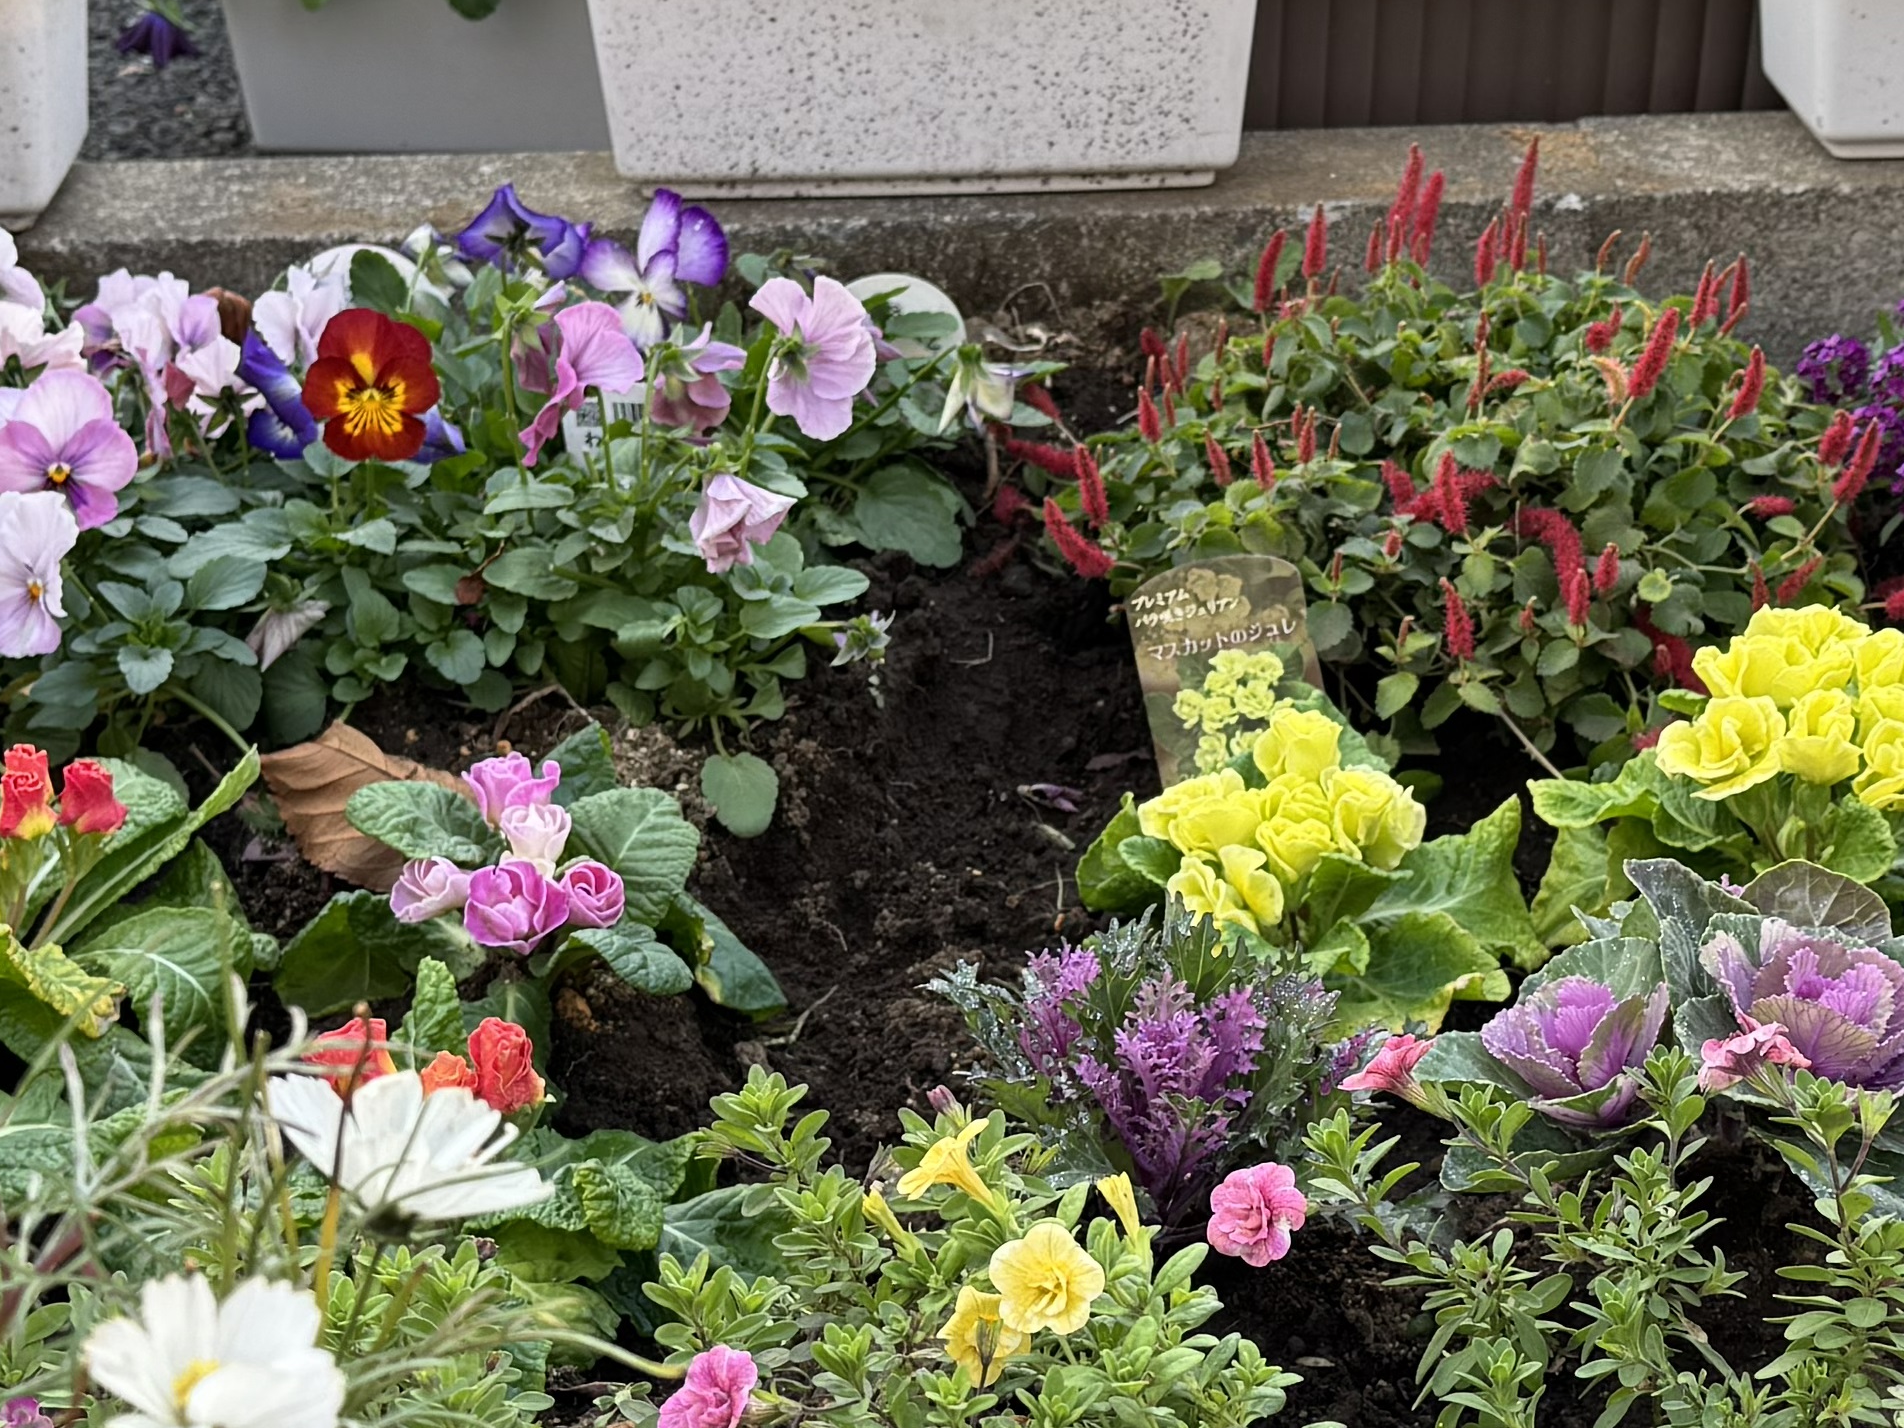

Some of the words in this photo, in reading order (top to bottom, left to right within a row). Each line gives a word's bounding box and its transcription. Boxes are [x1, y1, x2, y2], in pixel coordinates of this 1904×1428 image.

[1131, 588, 1190, 611] プレミアム
[1147, 618, 1296, 661] マスカットのジュレ
